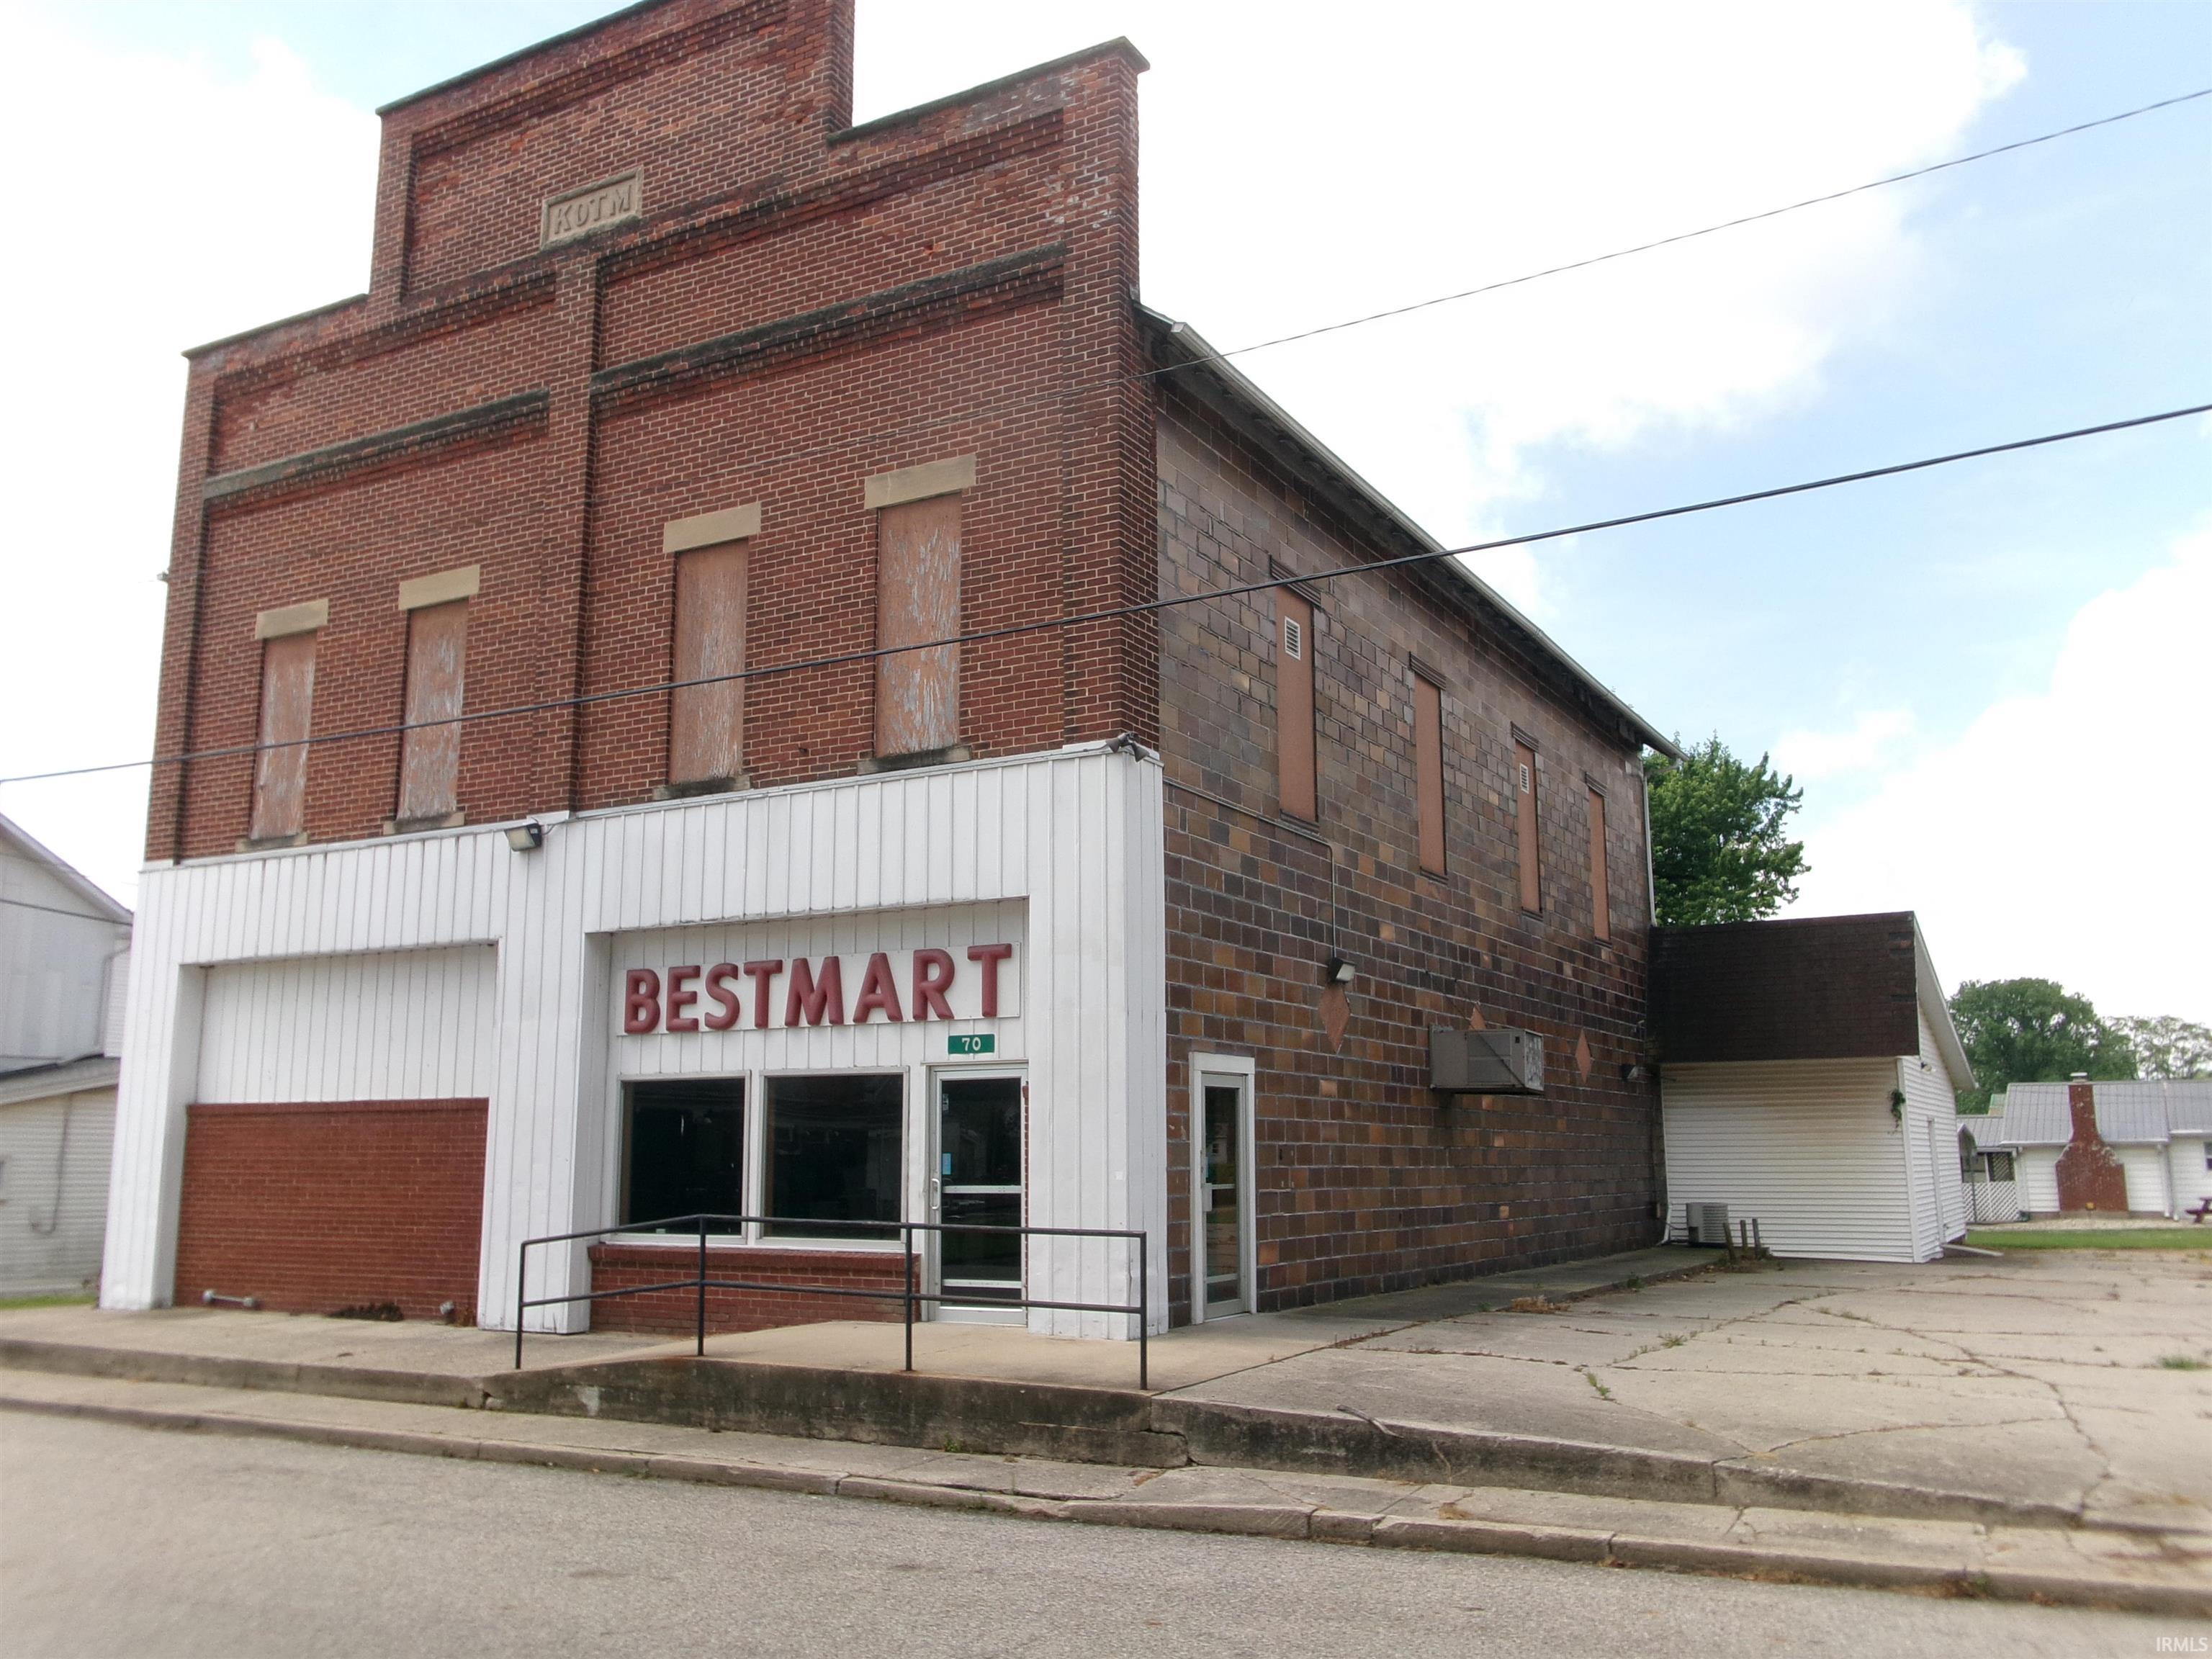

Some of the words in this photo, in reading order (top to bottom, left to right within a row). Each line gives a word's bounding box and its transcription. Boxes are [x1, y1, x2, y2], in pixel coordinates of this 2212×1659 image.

[554, 184, 632, 235] KOTM
[624, 943, 1012, 1034] BESTMART
[961, 1037, 981, 1051] 70
